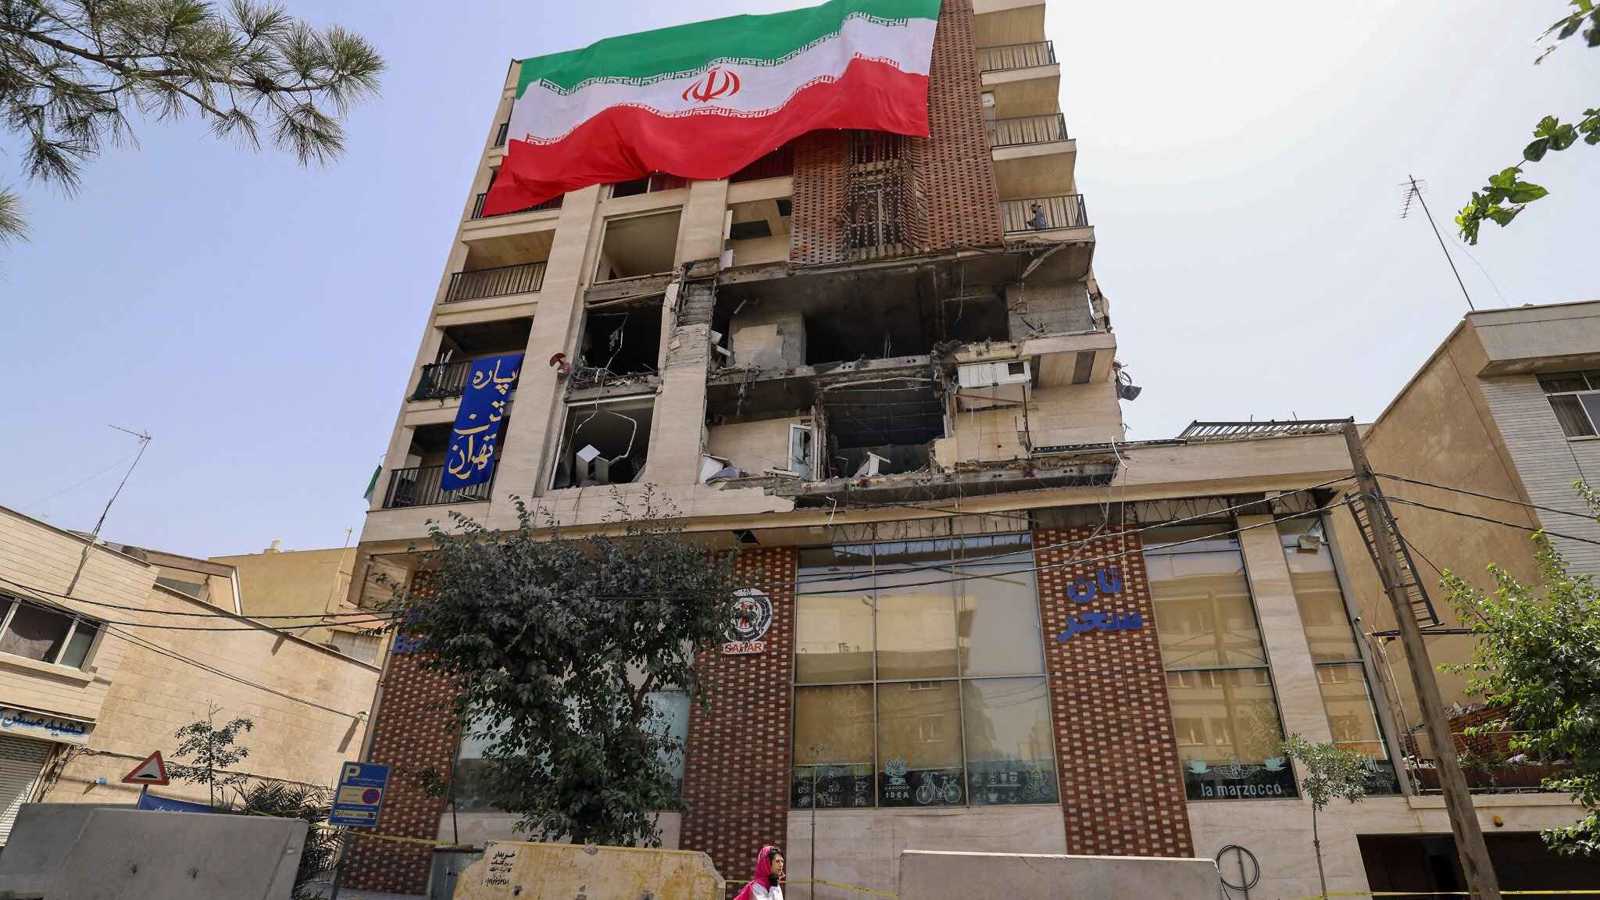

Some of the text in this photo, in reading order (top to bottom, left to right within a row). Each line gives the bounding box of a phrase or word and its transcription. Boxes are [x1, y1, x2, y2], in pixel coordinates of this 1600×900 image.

[472, 359, 519, 395] پاره
[447, 433, 498, 480] تهران
[1065, 565, 1122, 603] نان
[342, 765, 360, 783] P
[1200, 783, 1282, 797] la marzocco
